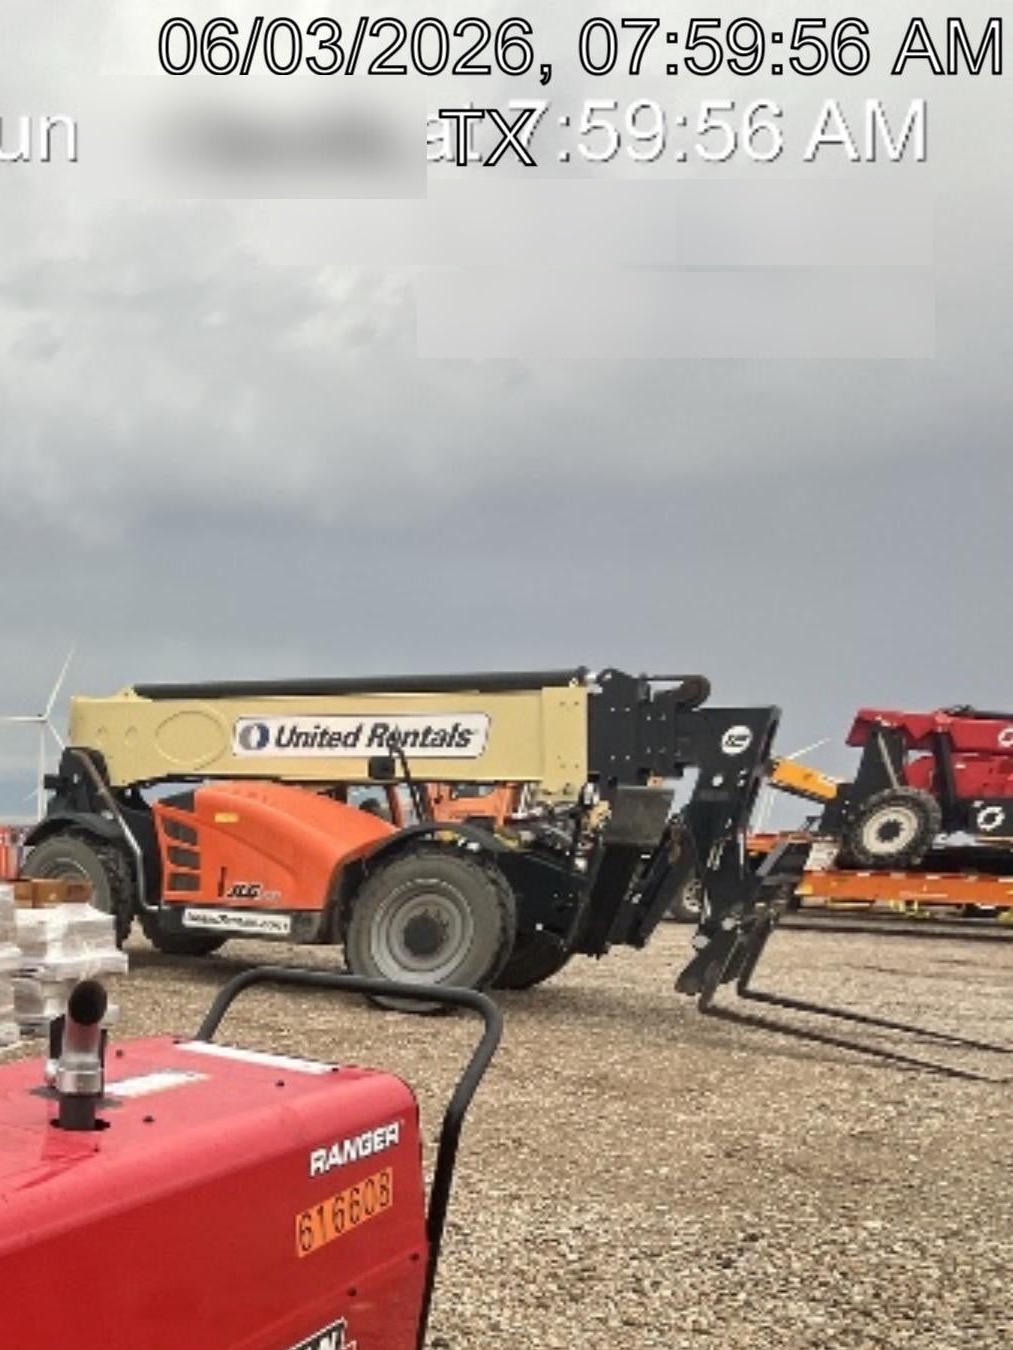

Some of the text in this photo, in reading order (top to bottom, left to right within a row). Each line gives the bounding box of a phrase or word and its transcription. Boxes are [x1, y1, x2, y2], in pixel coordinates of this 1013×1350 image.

[275, 722, 474, 749] United Rentals
[309, 1121, 400, 1177] RANGER
